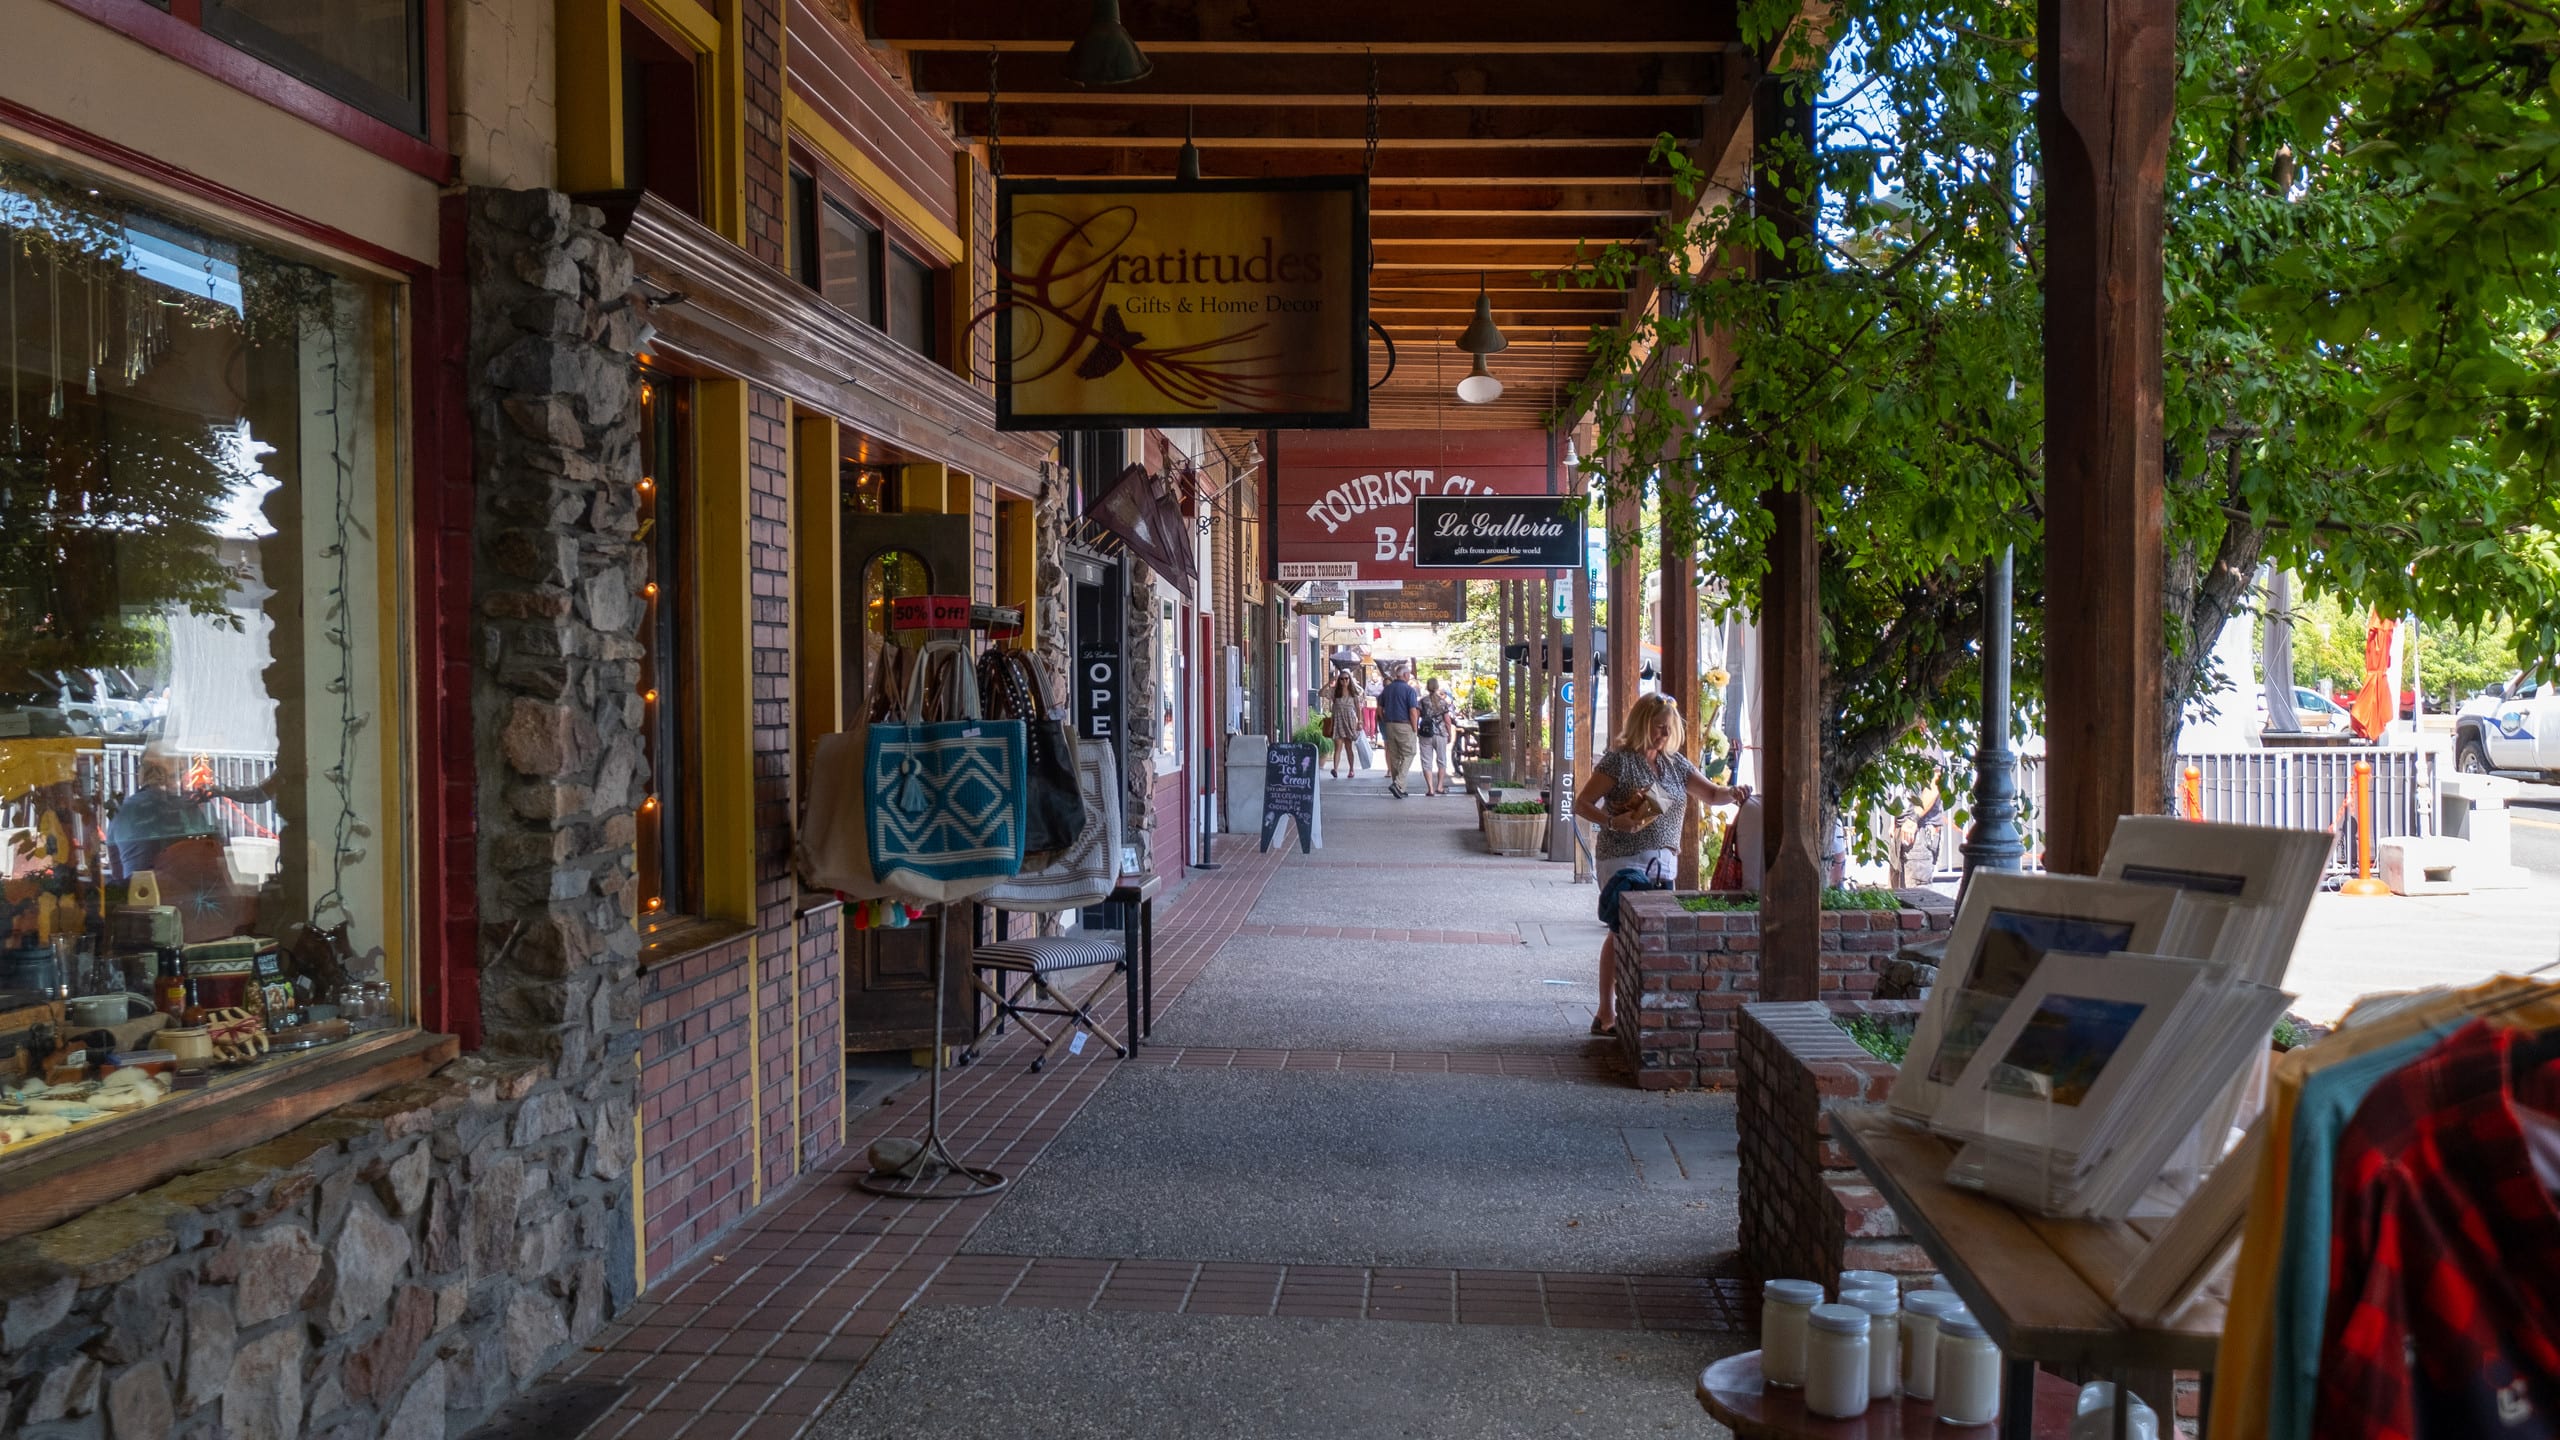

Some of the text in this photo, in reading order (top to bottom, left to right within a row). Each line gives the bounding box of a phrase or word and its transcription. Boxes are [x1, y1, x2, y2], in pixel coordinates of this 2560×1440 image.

[1126, 294, 1323, 313] Gifts & Home Decor
[1306, 470, 1434, 534] TOURIST
[1433, 512, 1563, 537] La Galleria
[1454, 546, 1542, 556] gifts from around the world
[1283, 564, 1353, 577] FREE BEER TOMORROW
[896, 605, 964, 620] 50% Off!
[1089, 662, 1112, 736] OPE
[1269, 750, 1297, 765] Bud's
[1278, 763, 1297, 775] Ice
[1281, 774, 1312, 789] Cream
[1562, 773, 1574, 787] to
[1560, 790, 1575, 822] Park
